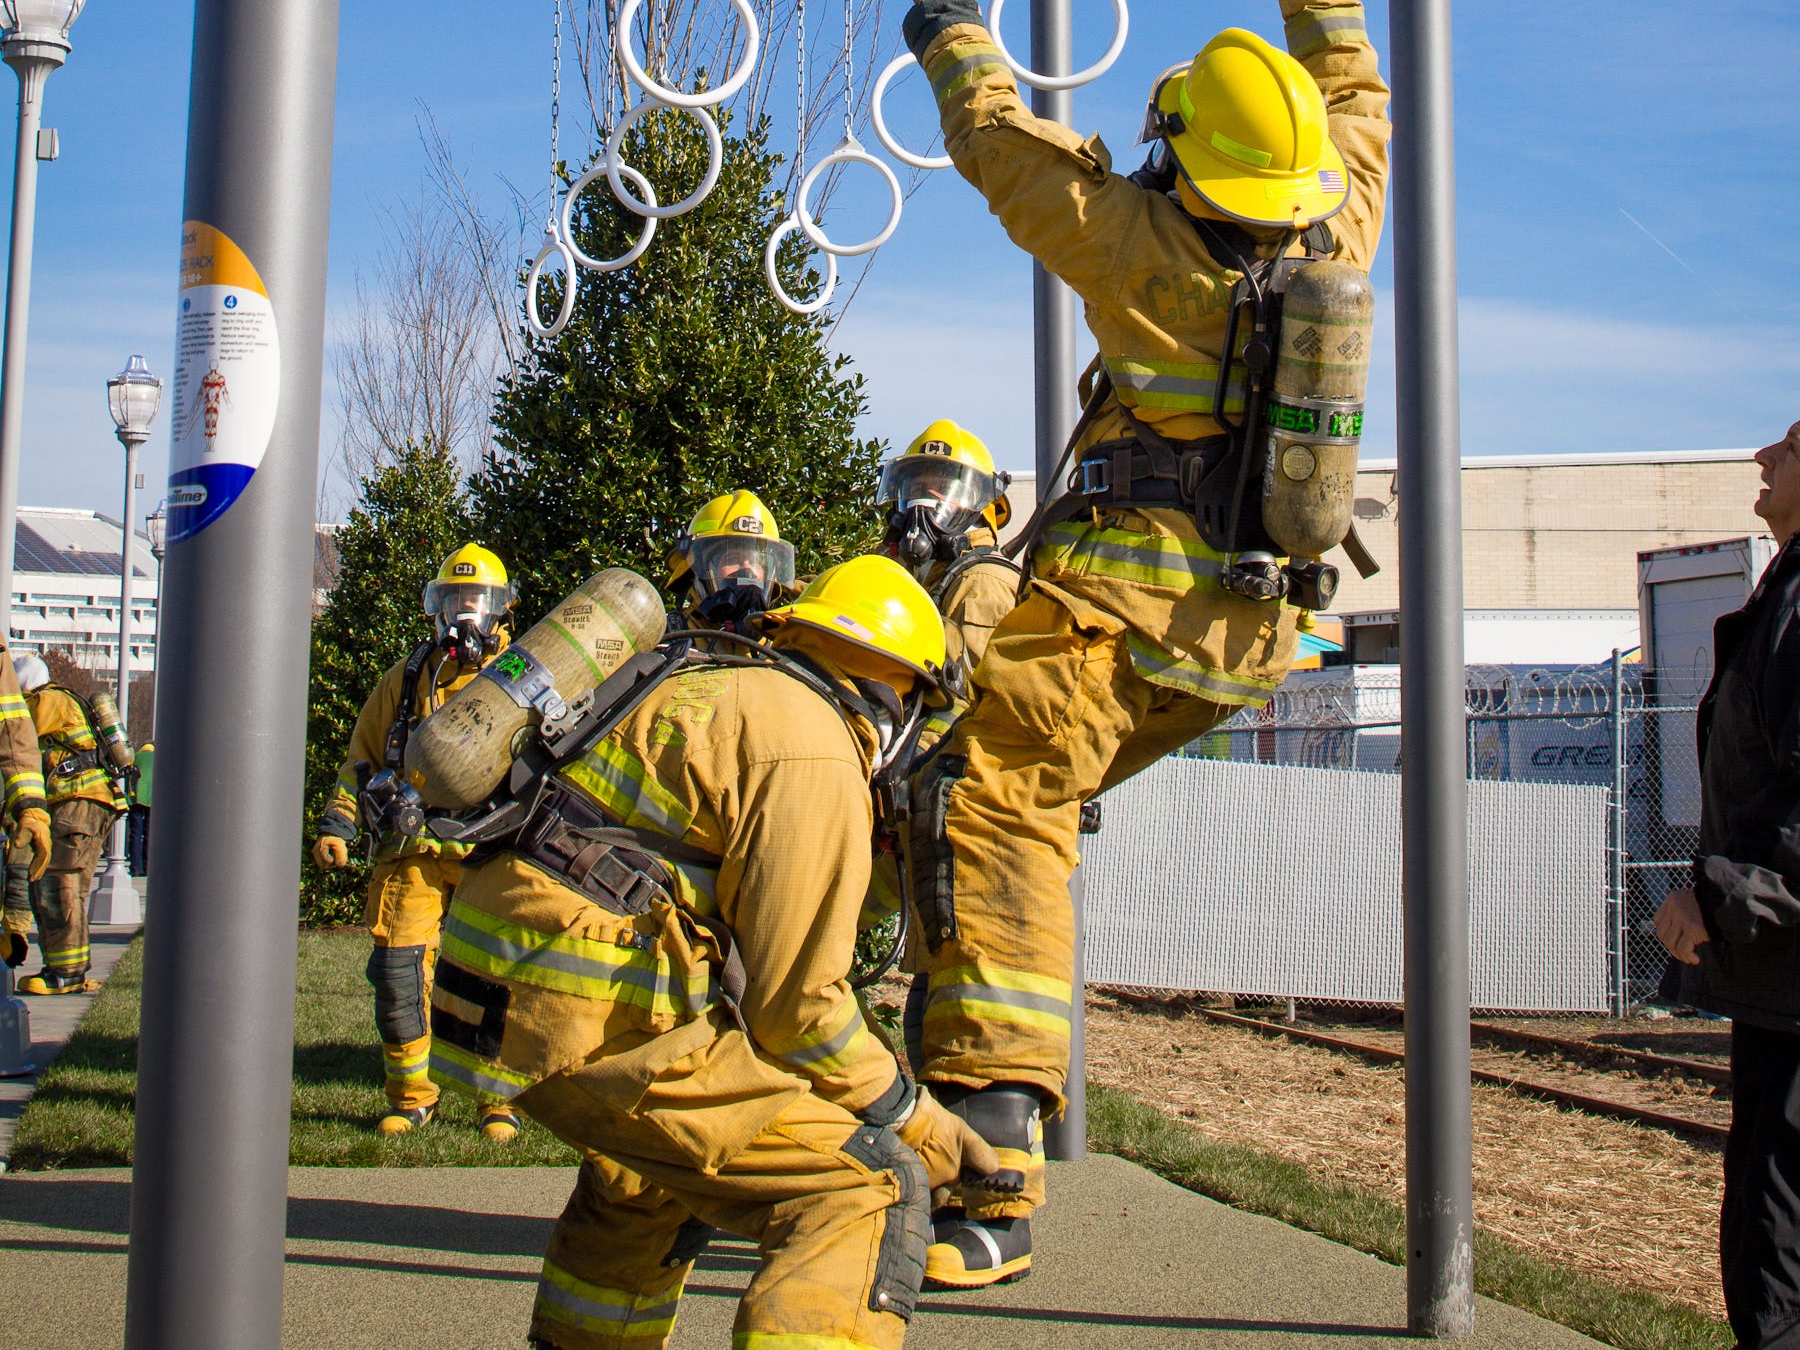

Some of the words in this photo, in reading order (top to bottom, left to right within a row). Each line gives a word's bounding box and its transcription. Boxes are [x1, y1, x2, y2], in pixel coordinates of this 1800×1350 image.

[1267, 403, 1317, 433] MSA
[925, 441, 945, 455] C1
[738, 516, 760, 533] C2
[455, 564, 473, 574] C11
[563, 605, 593, 616] MSA
[596, 639, 624, 651] MSA
